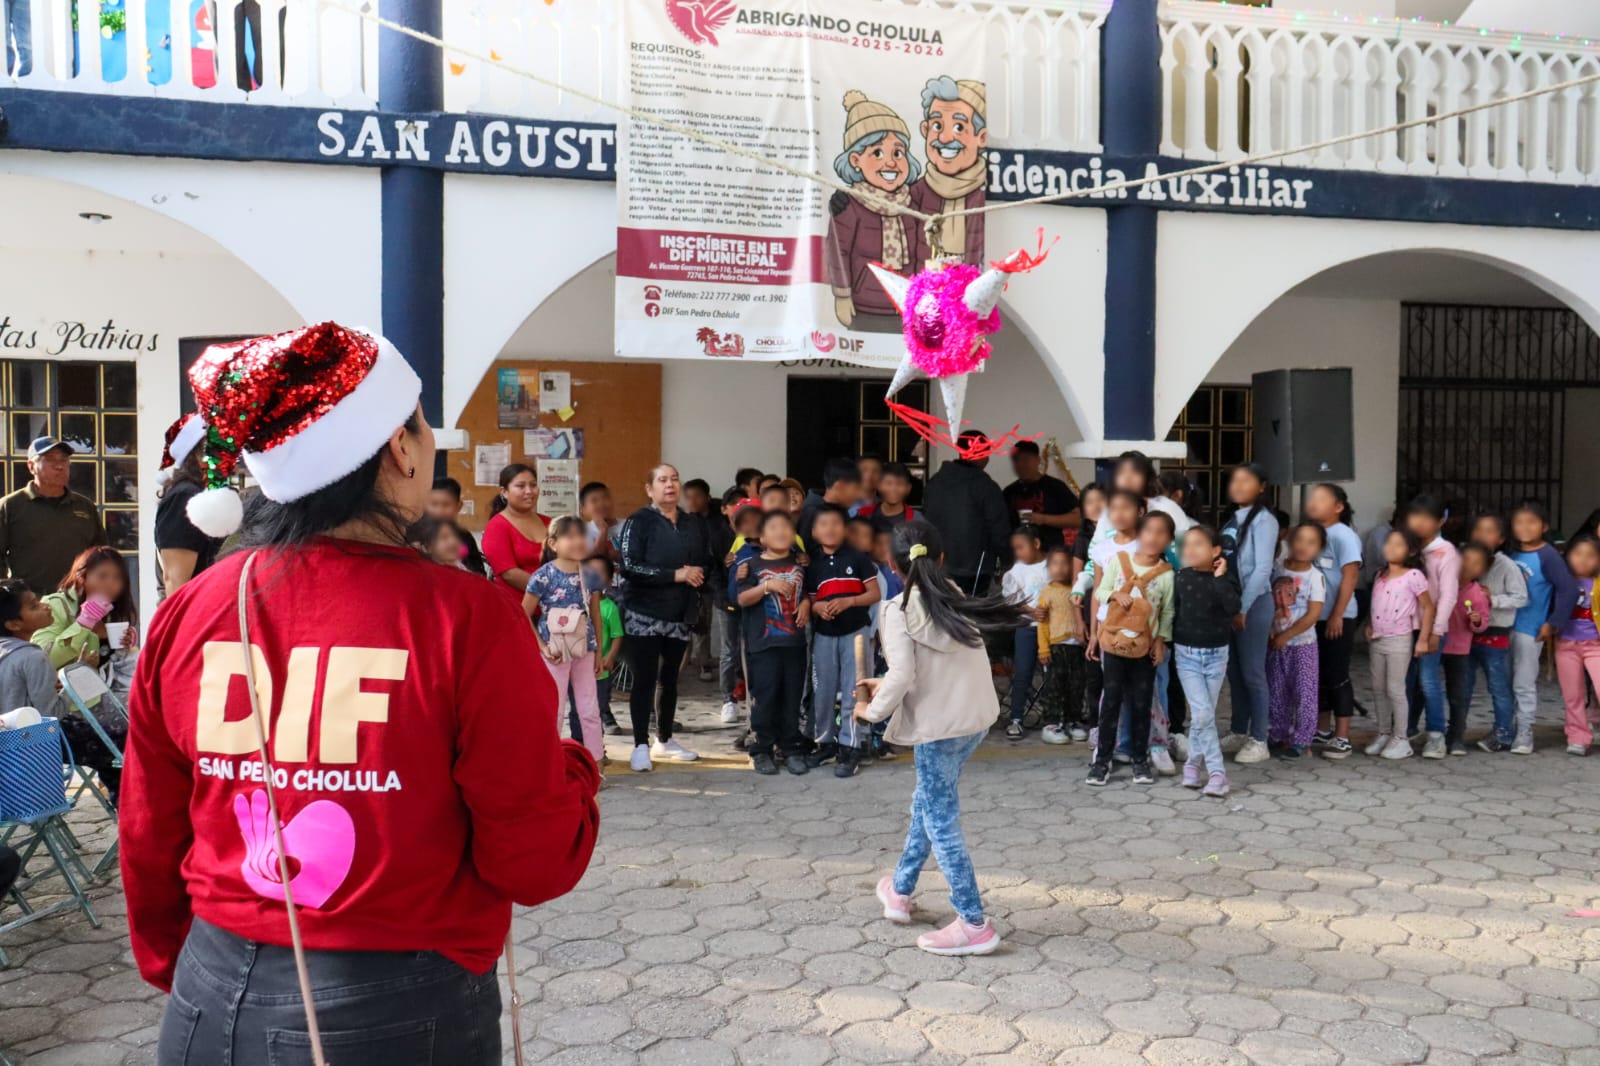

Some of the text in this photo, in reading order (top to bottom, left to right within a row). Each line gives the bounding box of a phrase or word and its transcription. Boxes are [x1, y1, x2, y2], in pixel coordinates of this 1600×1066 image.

[736, 9, 943, 44] ABRIGANDO CHOLULA
[631, 42, 705, 60] REQUISITOS:
[851, 36, 944, 57] 2025-2026
[317, 111, 430, 161] SAN
[985, 151, 1313, 209] idencia Auxiliar
[660, 234, 787, 256] INSCRÍBETE EN EL
[670, 248, 778, 268] DIF MUNICIPAL
[664, 288, 788, 303] Teléfono: 222 777 2900 ext. 3902
[662, 306, 740, 319] DIF San Pedro Cholula
[46, 318, 158, 355] Patrias
[838, 336, 864, 352] DIF
[197, 640, 409, 764] DIF
[198, 757, 234, 780] SAN
[292, 767, 402, 792] CHOLULA
